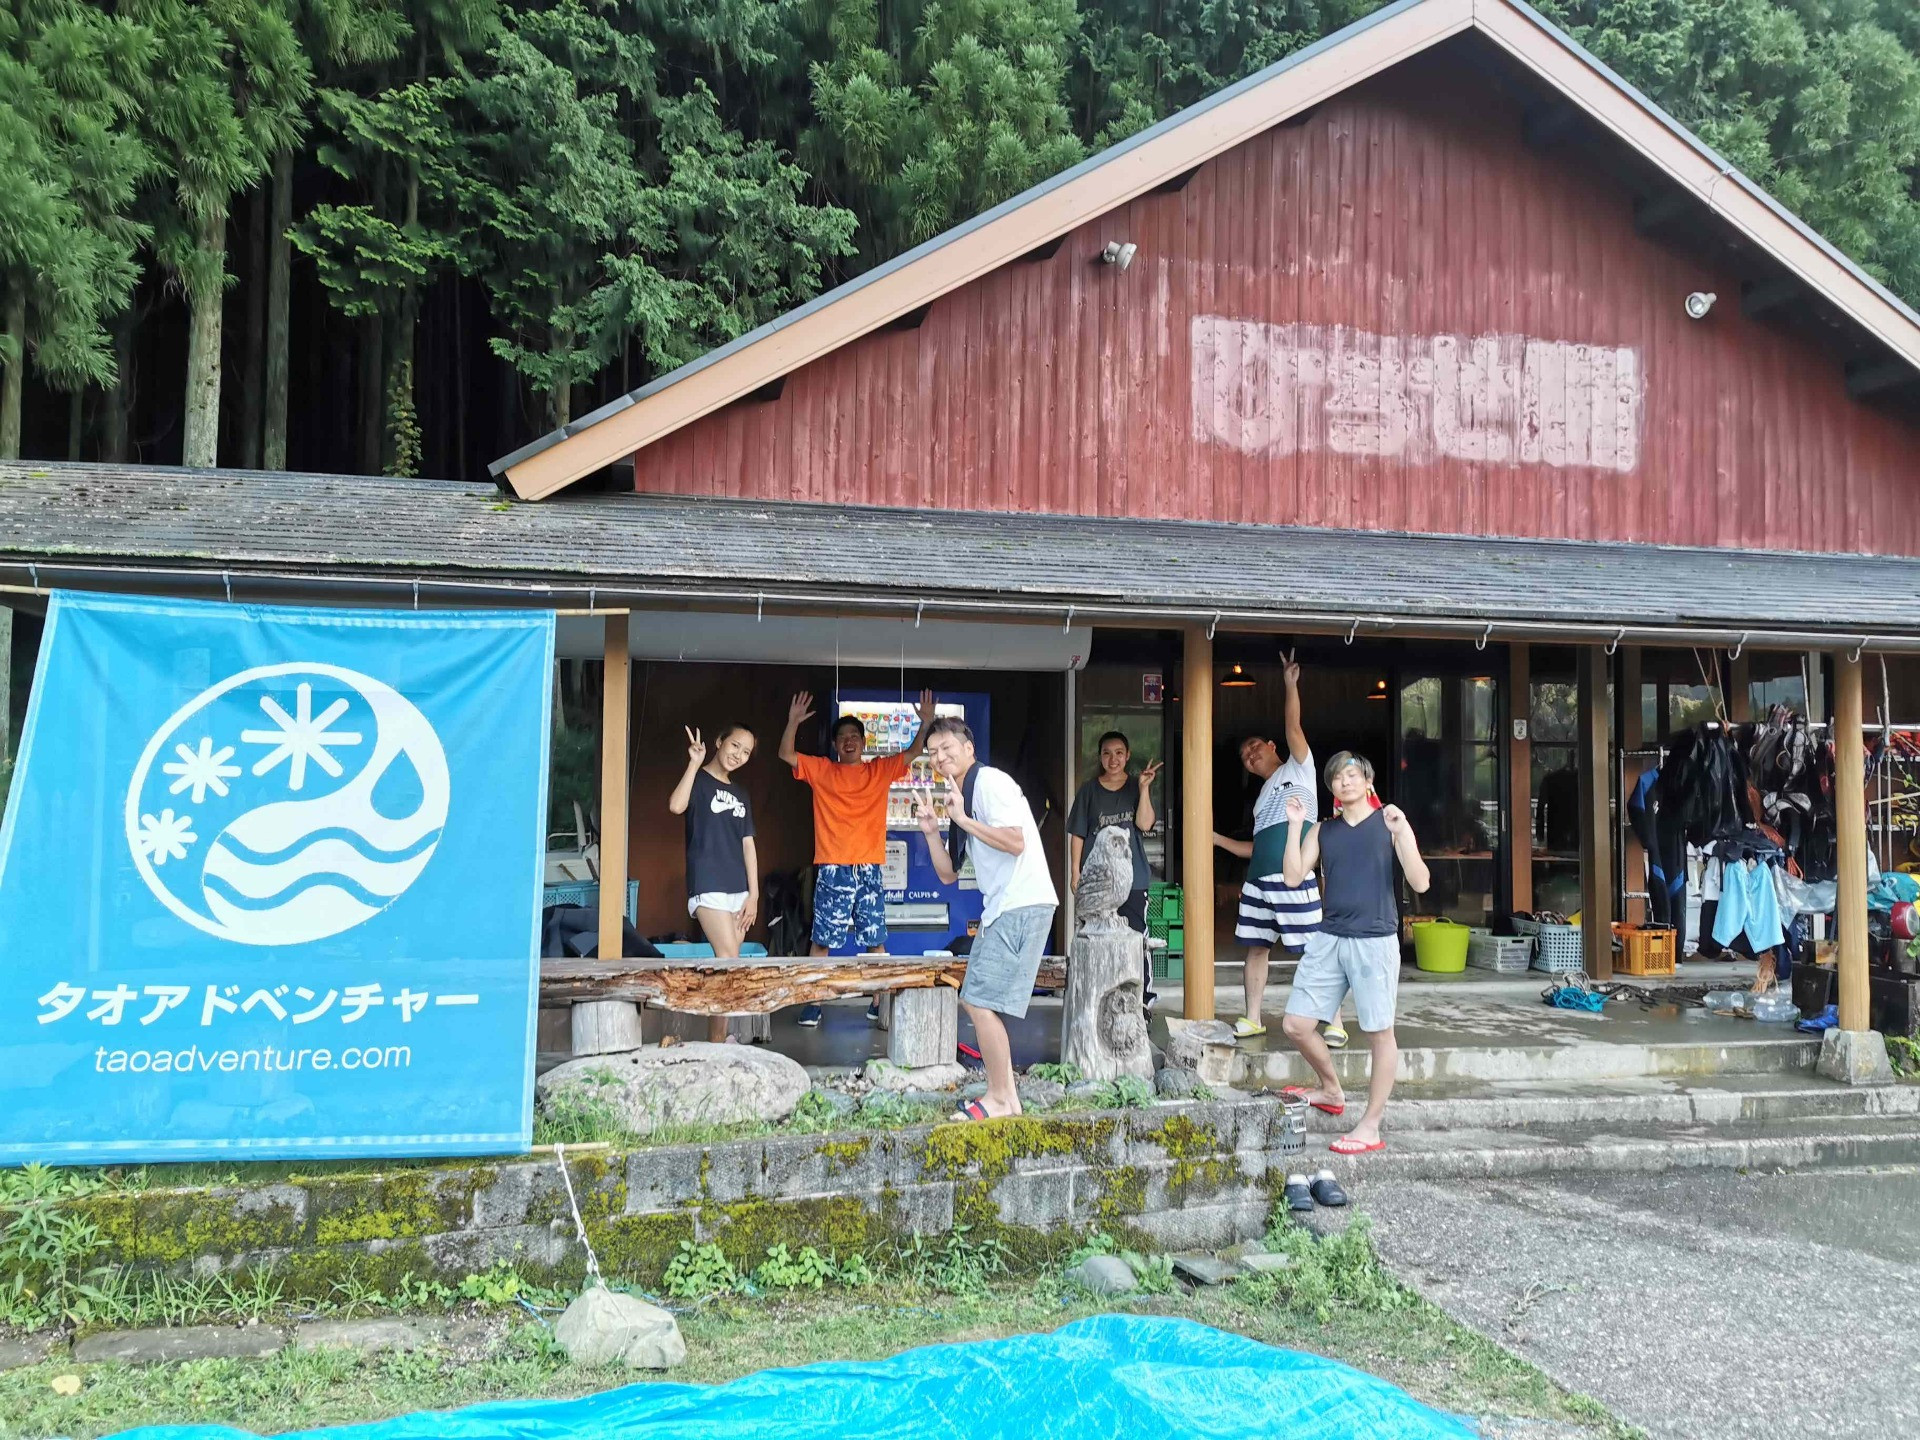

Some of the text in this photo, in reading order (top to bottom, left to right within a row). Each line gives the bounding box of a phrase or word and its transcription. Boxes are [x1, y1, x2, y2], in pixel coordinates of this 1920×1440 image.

[37, 982, 480, 1026] タオアドベンチャー
[94, 1044, 411, 1073] taoadventure.com
